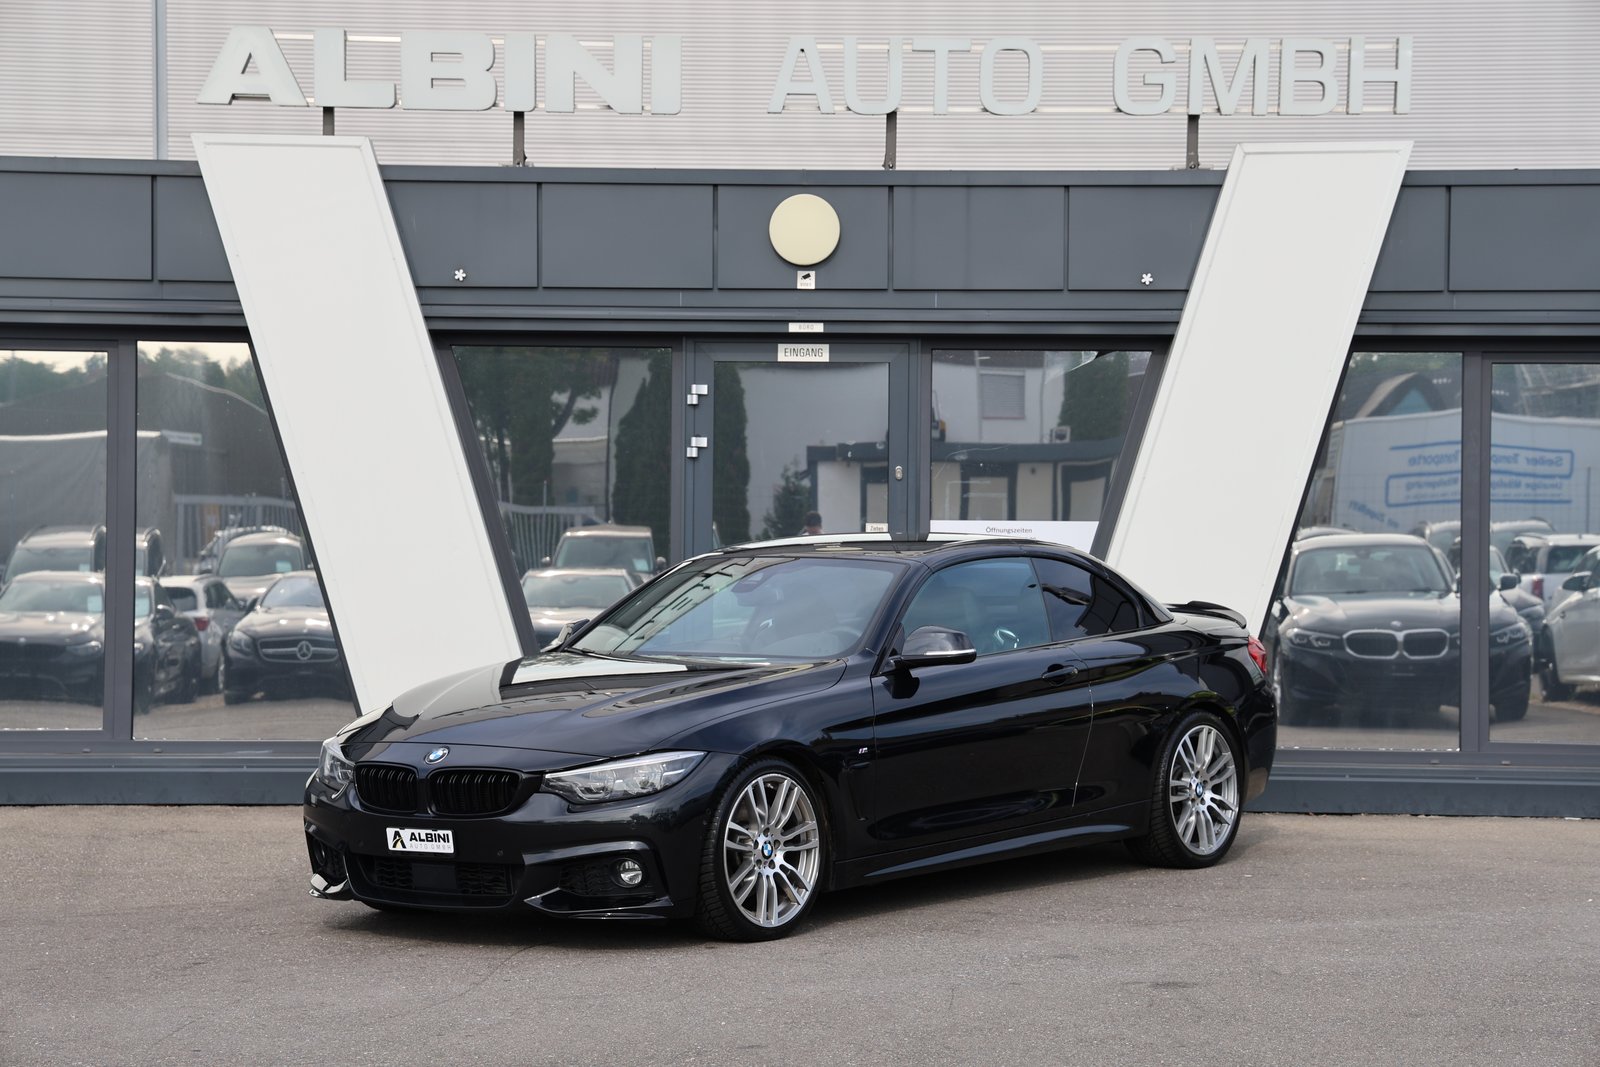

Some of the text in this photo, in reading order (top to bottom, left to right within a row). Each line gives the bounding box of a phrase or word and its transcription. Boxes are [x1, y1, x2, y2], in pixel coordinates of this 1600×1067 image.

[196, 26, 1413, 116] ALBINI AUTO GMBH
[784, 347, 823, 357] EINGANG
[985, 526, 1032, 534] Öffnungszeiten
[409, 832, 450, 843] ALBINI
